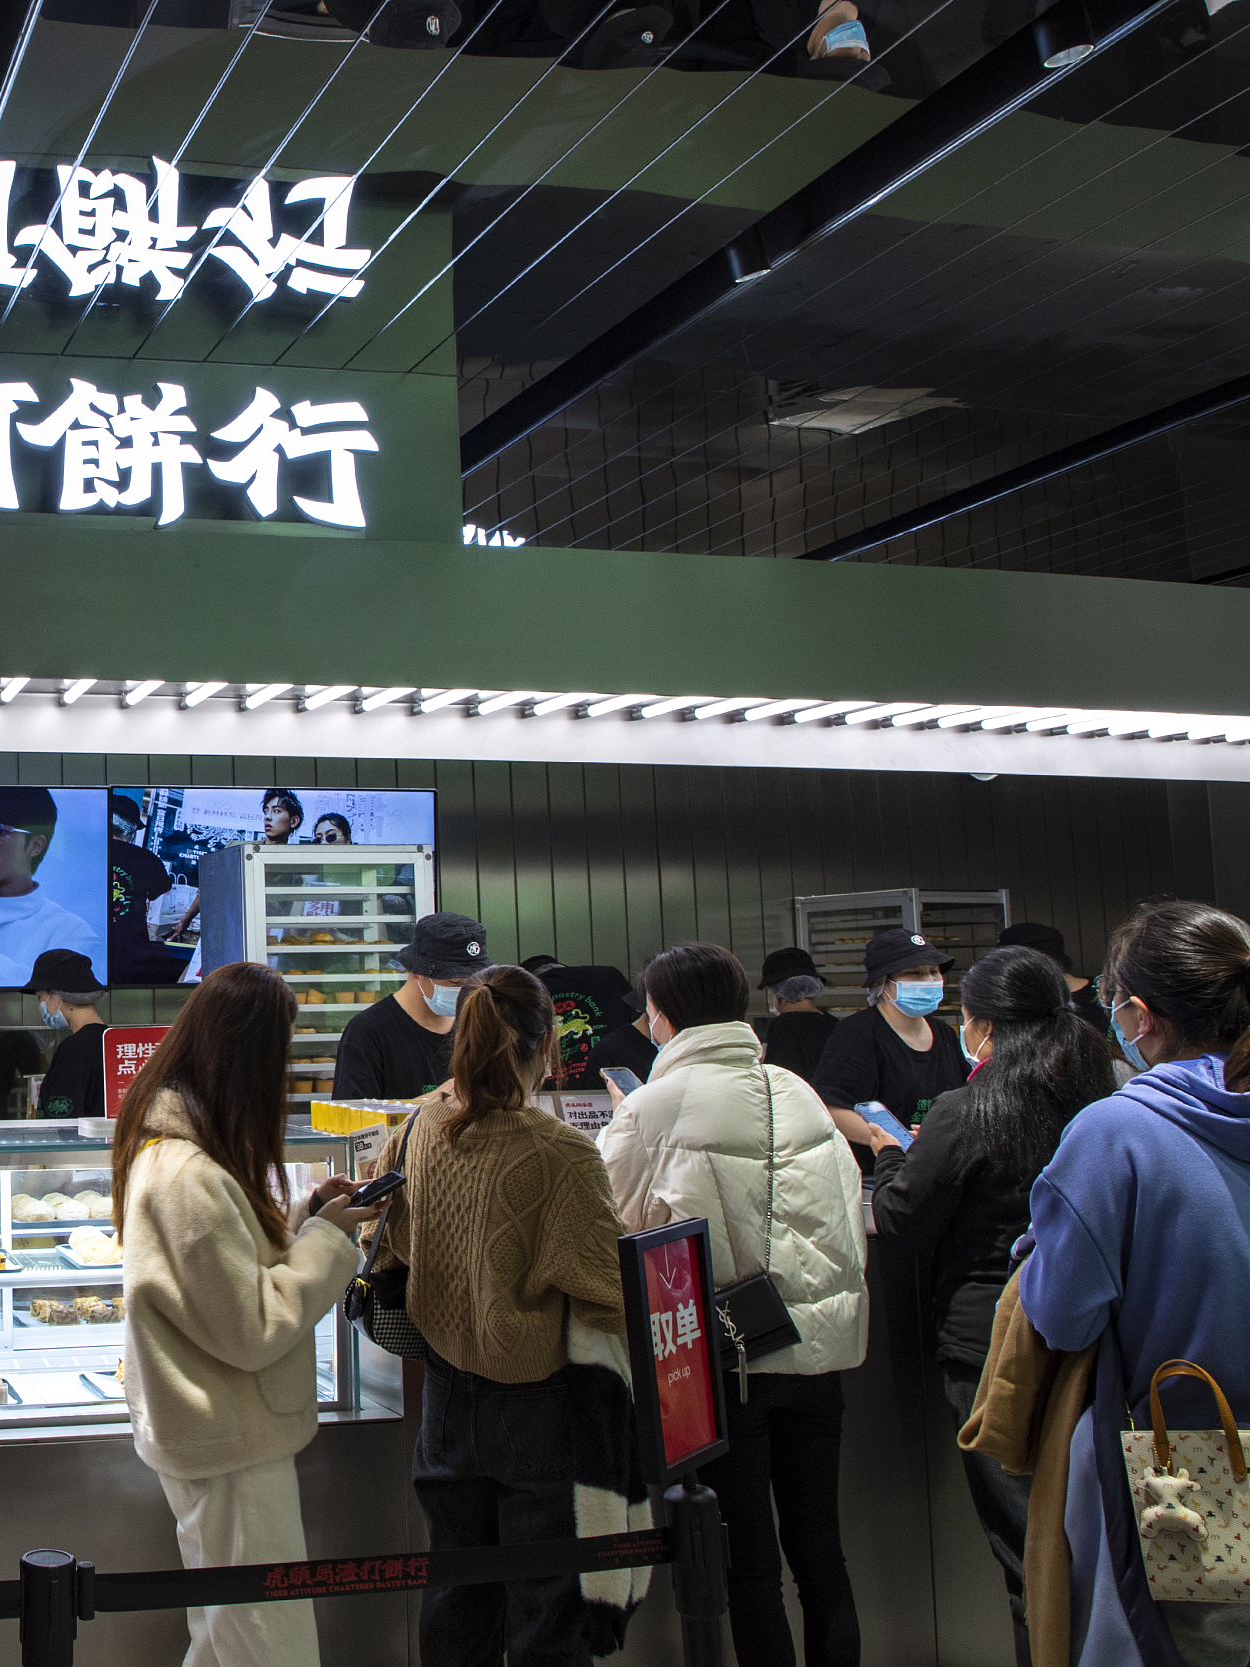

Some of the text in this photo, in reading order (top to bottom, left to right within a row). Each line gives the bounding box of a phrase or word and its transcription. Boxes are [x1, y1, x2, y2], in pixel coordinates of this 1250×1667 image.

[584, 995, 603, 1018] bank
[116, 1042, 161, 1059] 理性
[650, 1299, 701, 1361] 取单
[667, 1366, 691, 1386] pick up
[263, 1557, 430, 1588] 虎頭局渣打餅行
[290, 1586, 327, 1596] ATTITUDE
[329, 1582, 374, 1592] CHARTERED
[376, 1580, 405, 1588] PASTRY
[407, 1578, 428, 1586] BANK
